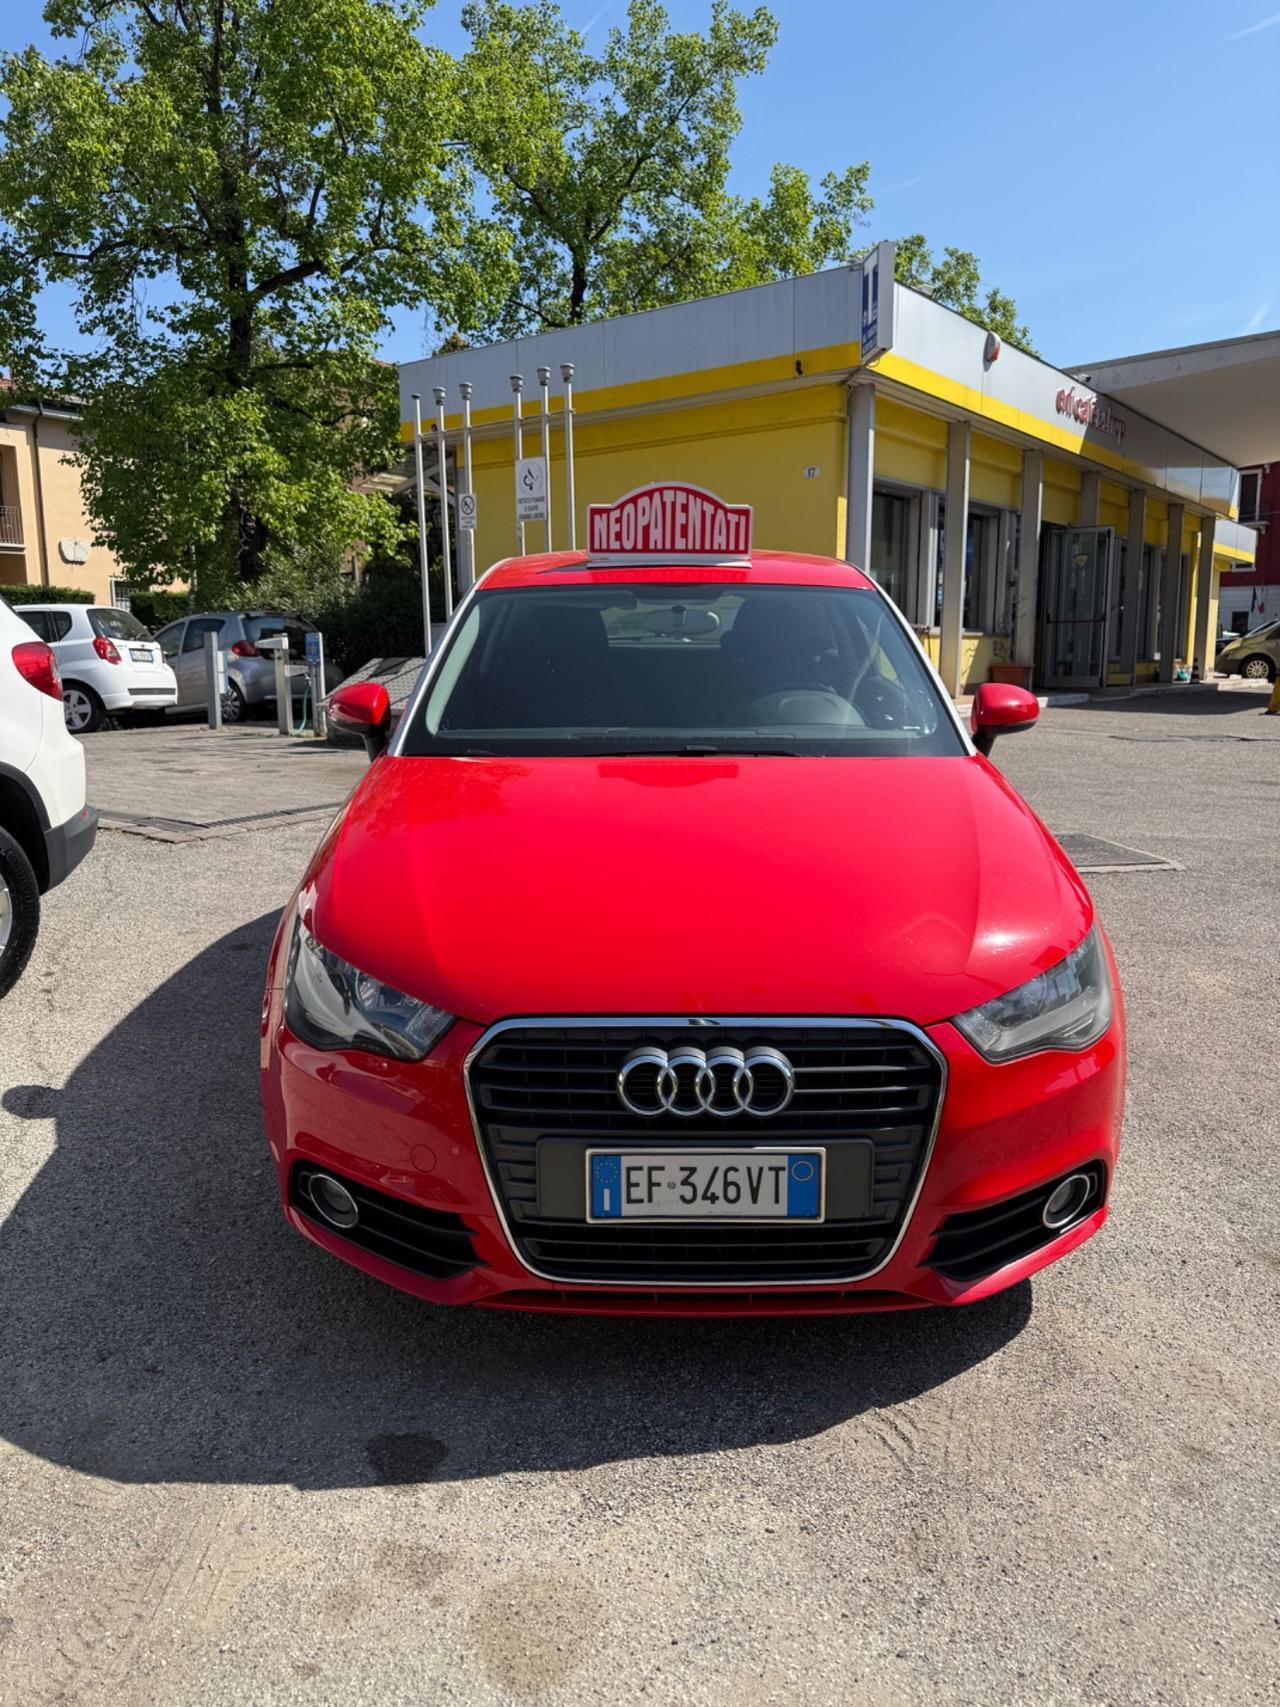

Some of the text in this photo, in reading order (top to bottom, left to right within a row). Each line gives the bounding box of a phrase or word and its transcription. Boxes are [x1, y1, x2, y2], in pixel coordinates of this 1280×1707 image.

[594, 489, 746, 551] NEOPATENTATI
[625, 1166, 666, 1205] EF
[679, 1165, 787, 1205] 346VT
